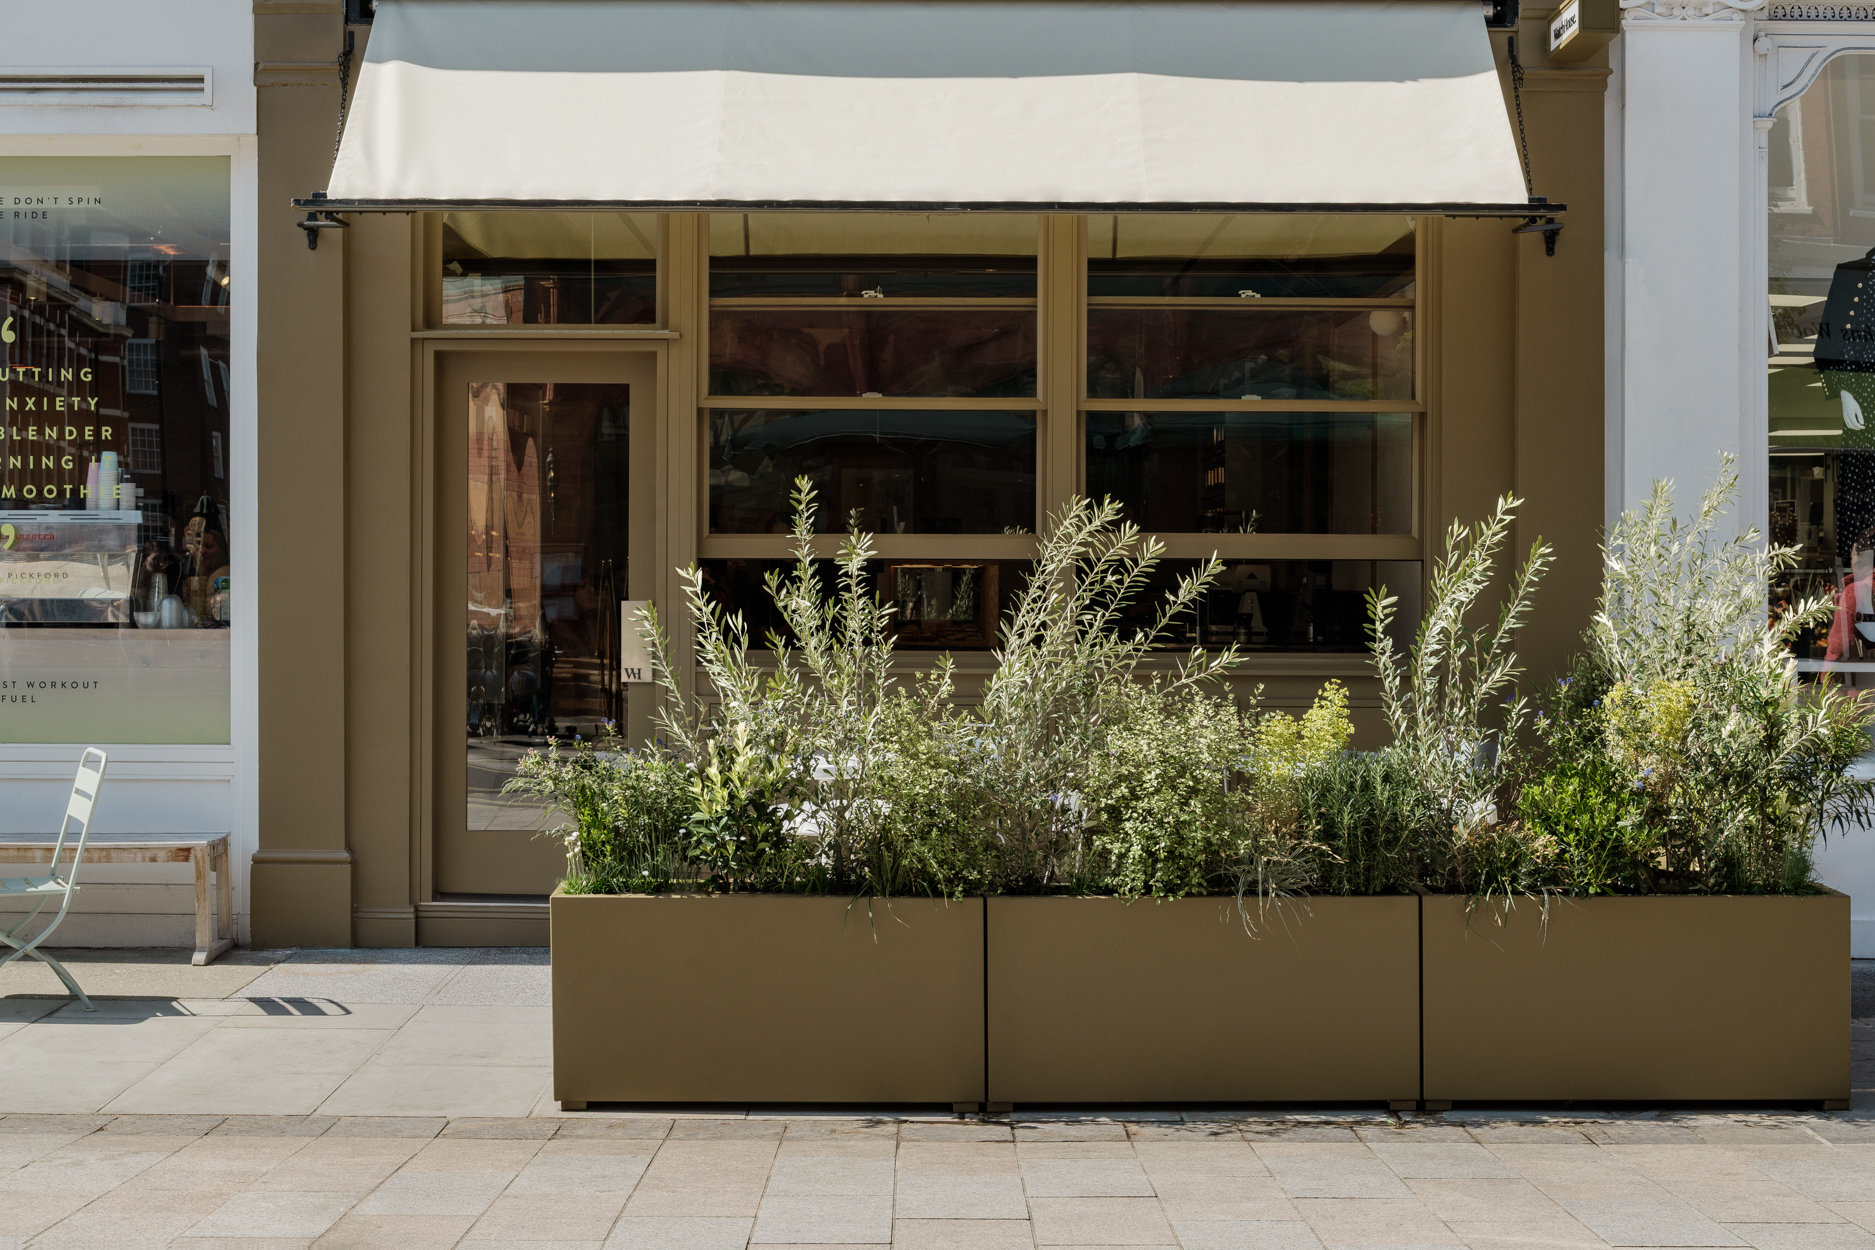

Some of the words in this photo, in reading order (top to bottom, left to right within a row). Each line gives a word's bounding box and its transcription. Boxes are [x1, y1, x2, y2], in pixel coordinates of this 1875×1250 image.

[14, 197, 59, 205] DON'T
[68, 197, 101, 205] SPIN
[14, 211, 48, 219] RIDE
[0, 367, 92, 382] UTTING
[6, 397, 98, 411] NXIETY
[92, 455, 112, 469] IT
[1, 484, 122, 499] MOOTHIE
[624, 667, 642, 680] WH
[26, 680, 99, 689] WORKOUT
[1, 694, 37, 703] FUEL
